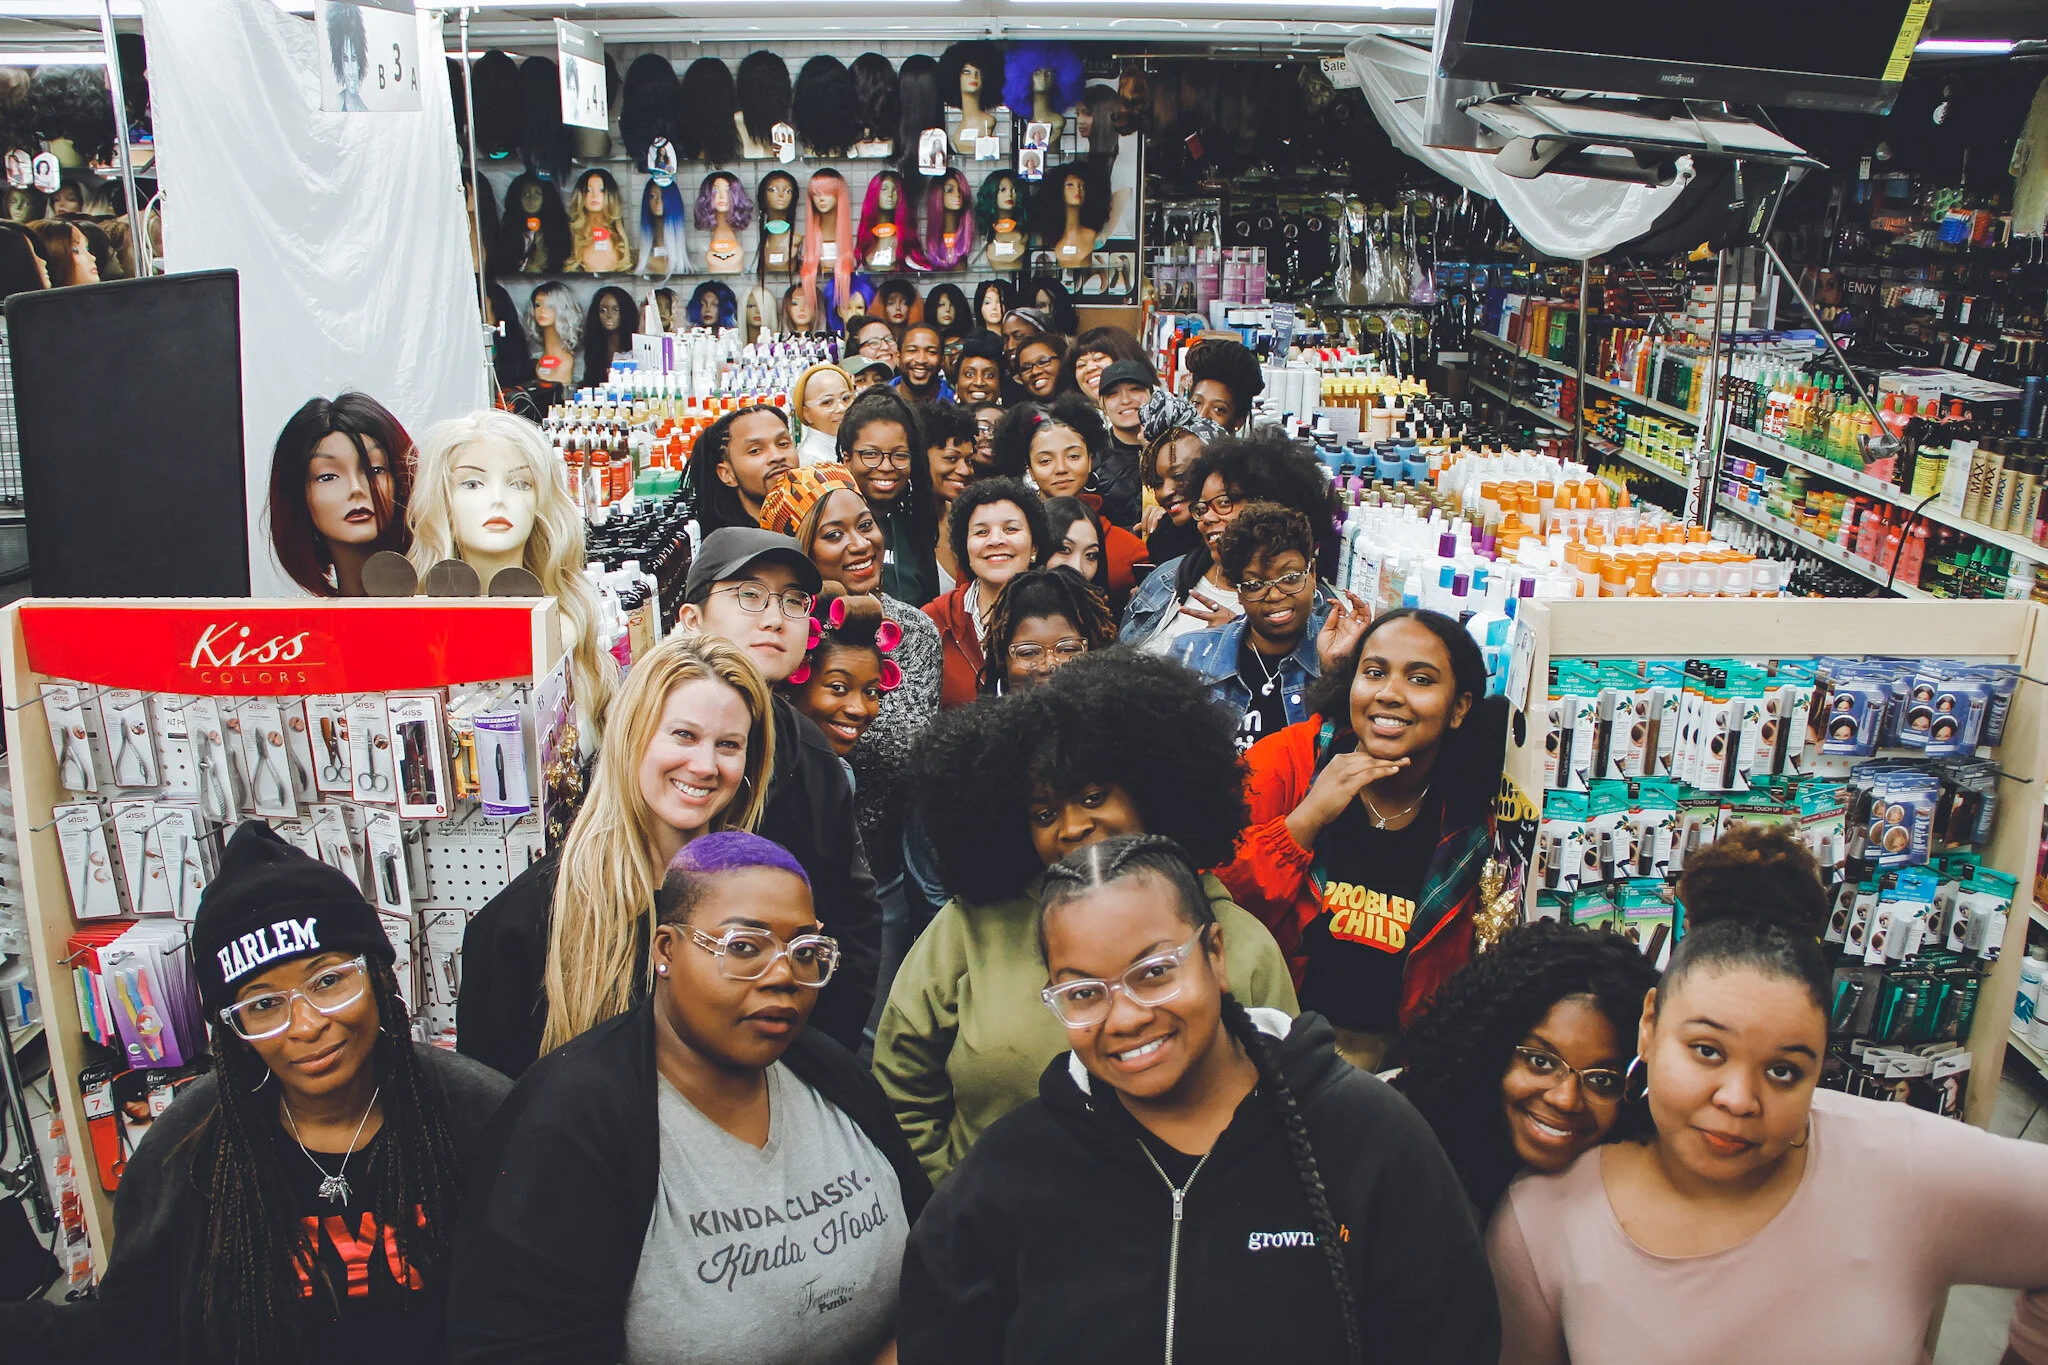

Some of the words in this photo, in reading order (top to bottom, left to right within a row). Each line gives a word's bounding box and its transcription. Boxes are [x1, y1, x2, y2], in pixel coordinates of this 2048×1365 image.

[378, 64, 386, 89] B
[392, 42, 402, 82] 3
[411, 66, 418, 91] A
[1323, 60, 1346, 72] Sale
[1661, 73, 1695, 85] INSIGNIA
[592, 84, 598, 110] 4
[1848, 281, 1876, 296] ENVY
[1971, 462, 1986, 494] MAX
[1984, 467, 1997, 498] MAX
[190, 621, 310, 669] Kiss
[201, 671, 307, 684] COLORS
[248, 703, 268, 711] KISS
[401, 709, 423, 717] KISS
[1328, 908, 1407, 952] CHILD
[217, 917, 320, 983] HARLEM
[86, 1081, 103, 1093] ICE
[91, 1099, 100, 1111] 7
[155, 1101, 165, 1112] 6
[786, 1169, 871, 1221] CLASSY.
[689, 1205, 787, 1238] KINDA
[813, 1191, 889, 1255] Hood.
[698, 1234, 806, 1293] Kinda
